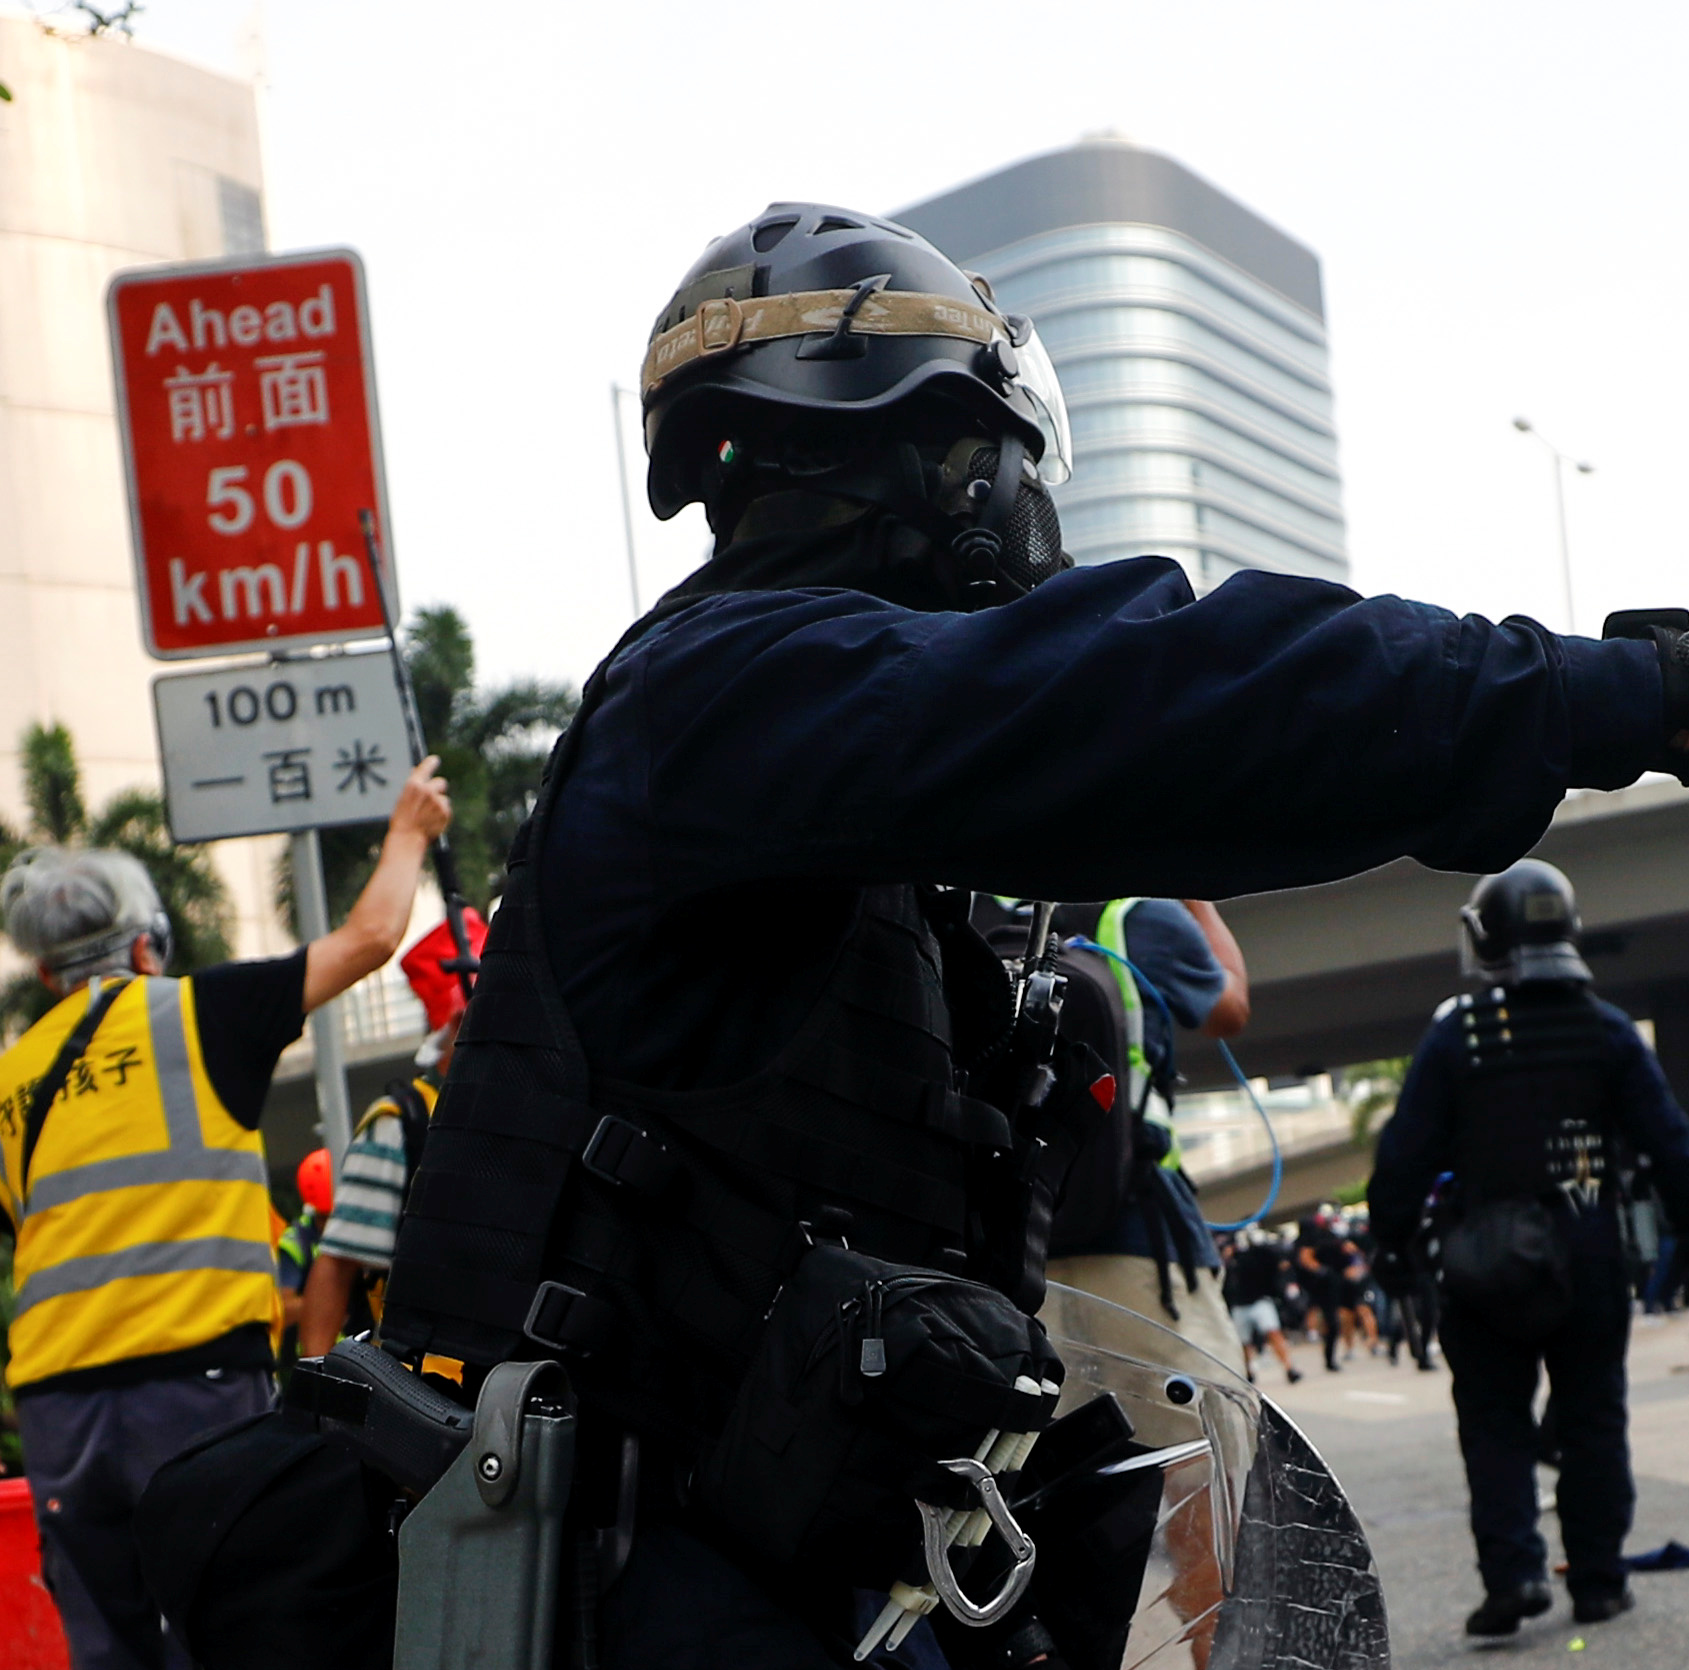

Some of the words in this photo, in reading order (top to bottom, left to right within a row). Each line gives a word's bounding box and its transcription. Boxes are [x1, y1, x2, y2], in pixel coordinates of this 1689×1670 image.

[144, 284, 337, 356] Ahead
[163, 350, 331, 443] 前面
[206, 459, 313, 536] 50
[169, 540, 365, 626] km/h
[204, 682, 298, 728] 100
[315, 683, 356, 716] m
[191, 738, 388, 804] 一百米
